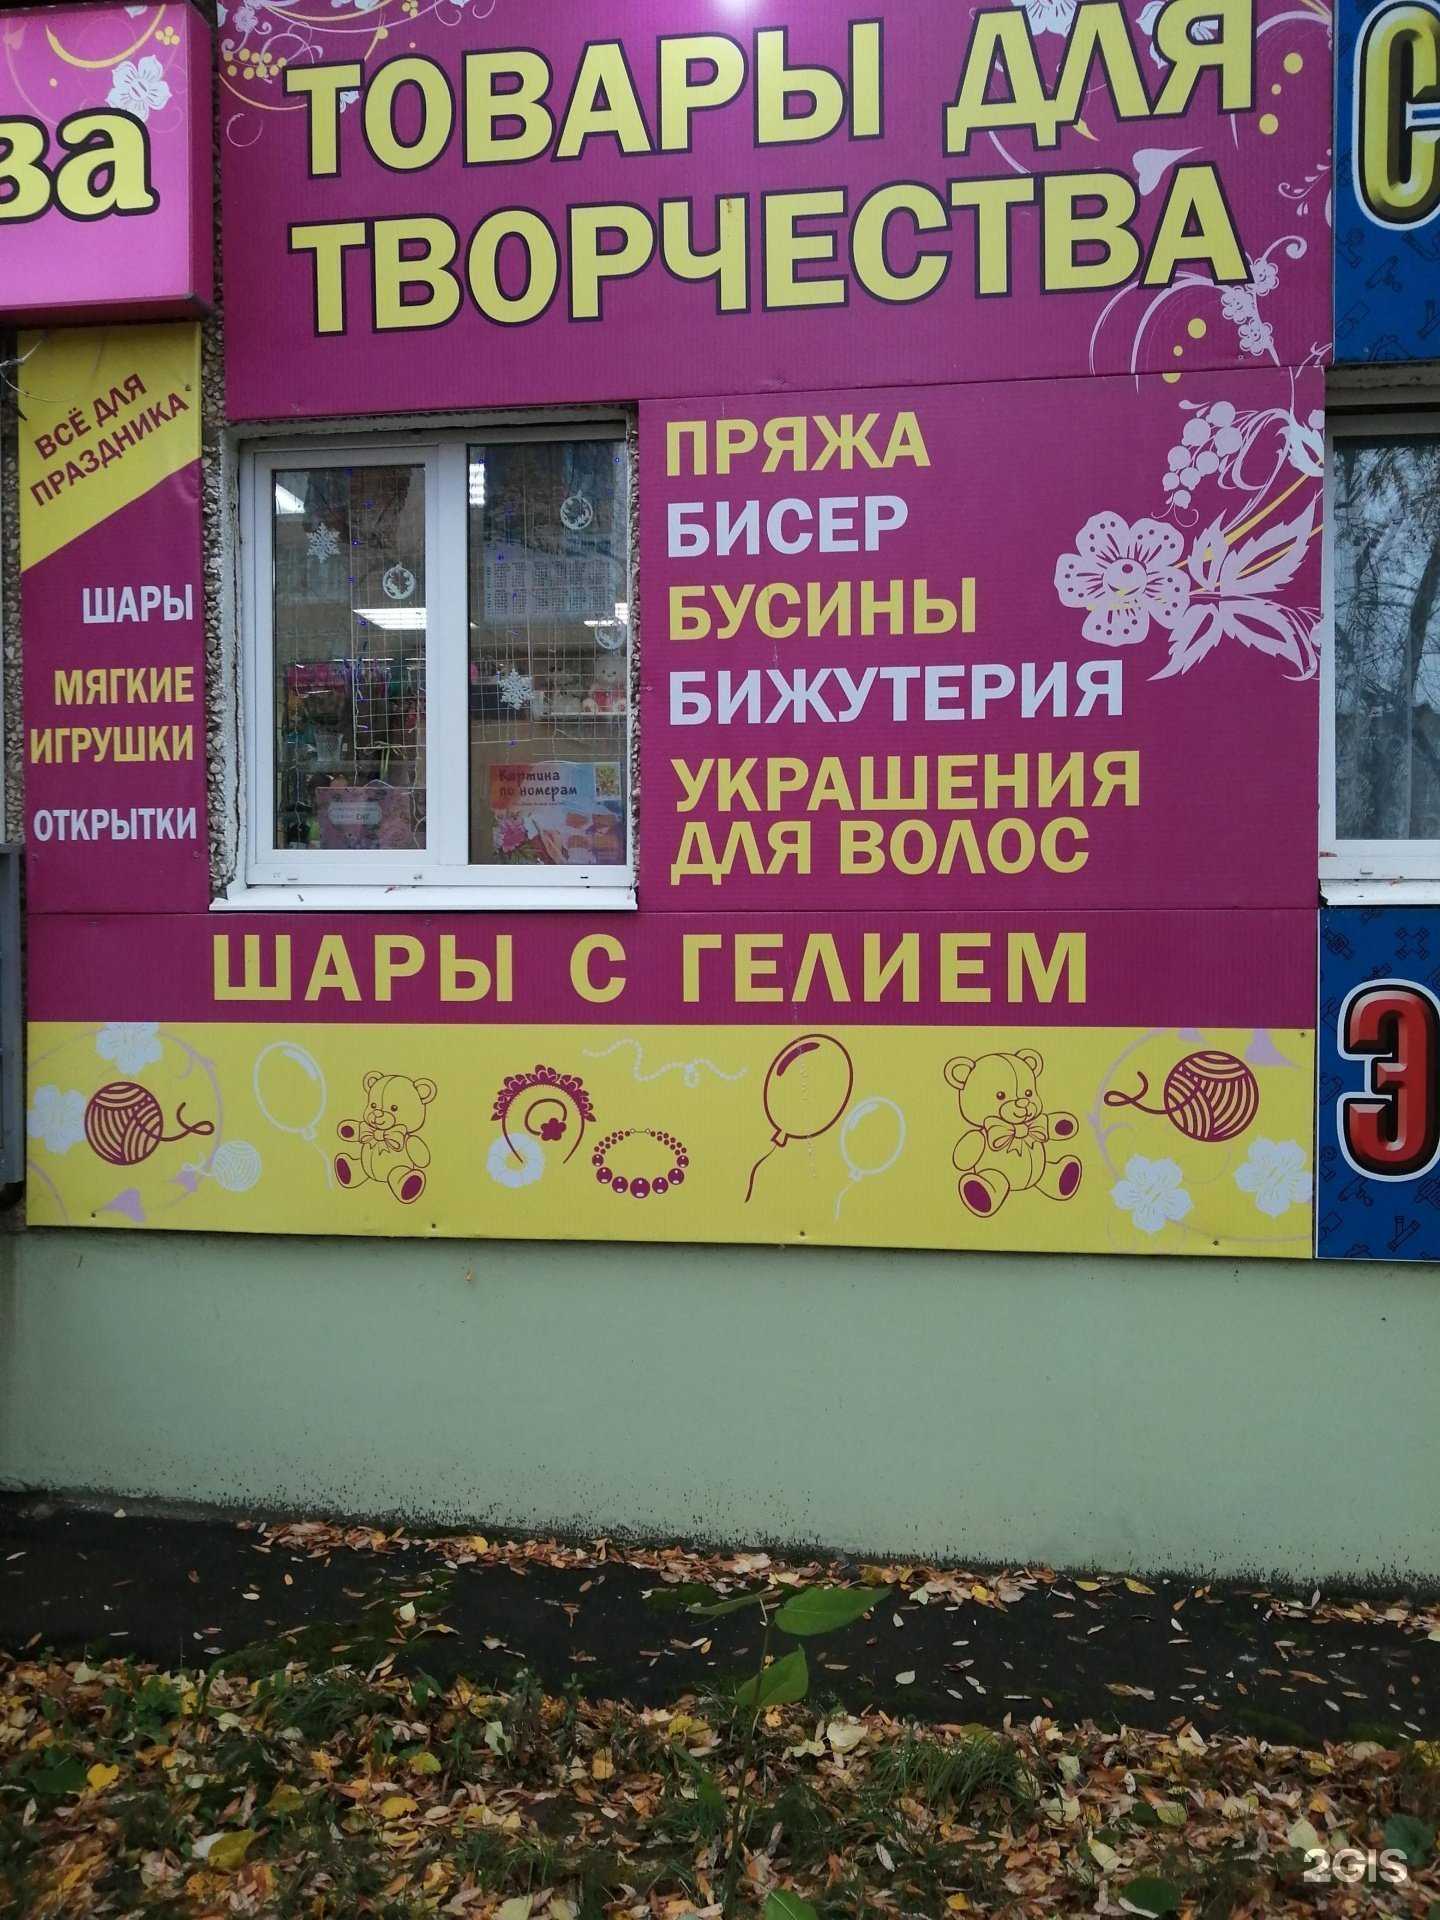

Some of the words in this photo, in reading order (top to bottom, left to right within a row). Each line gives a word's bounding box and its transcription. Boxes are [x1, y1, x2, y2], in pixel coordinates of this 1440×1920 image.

[284, 17, 883, 178] ТОВАРЫ
[942, 0, 1256, 157] ДЛЯ
[288, 162, 1253, 336] ТВОРЧЕСТВА
[34, 407, 92, 460] ВСЁ
[93, 373, 147, 428] ДЛЯ
[666, 411, 931, 476] ПРЯЖКА
[30, 392, 190, 507] ПРАЗДНИКА
[667, 495, 908, 558] БИСЕР
[82, 584, 193, 624] ШАРЫ
[669, 577, 976, 641] БУСИНЫ
[54, 666, 194, 706] МЯГКИЕ
[669, 659, 1123, 725] БИЖУТЕРИЯ
[30, 725, 193, 764] ИГРУШКИ
[520, 784, 578, 802] номерам
[670, 750, 1140, 812] УКРАШЕНИЯ
[33, 807, 197, 842] ОТКРЫТКИ
[670, 821, 811, 885] ДЛЯ
[840, 817, 1089, 875] ВОЛОС
[213, 934, 513, 1002] ШАРЫ
[569, 933, 627, 1003] С
[682, 932, 1087, 1003] ГЕЛИЕМ
